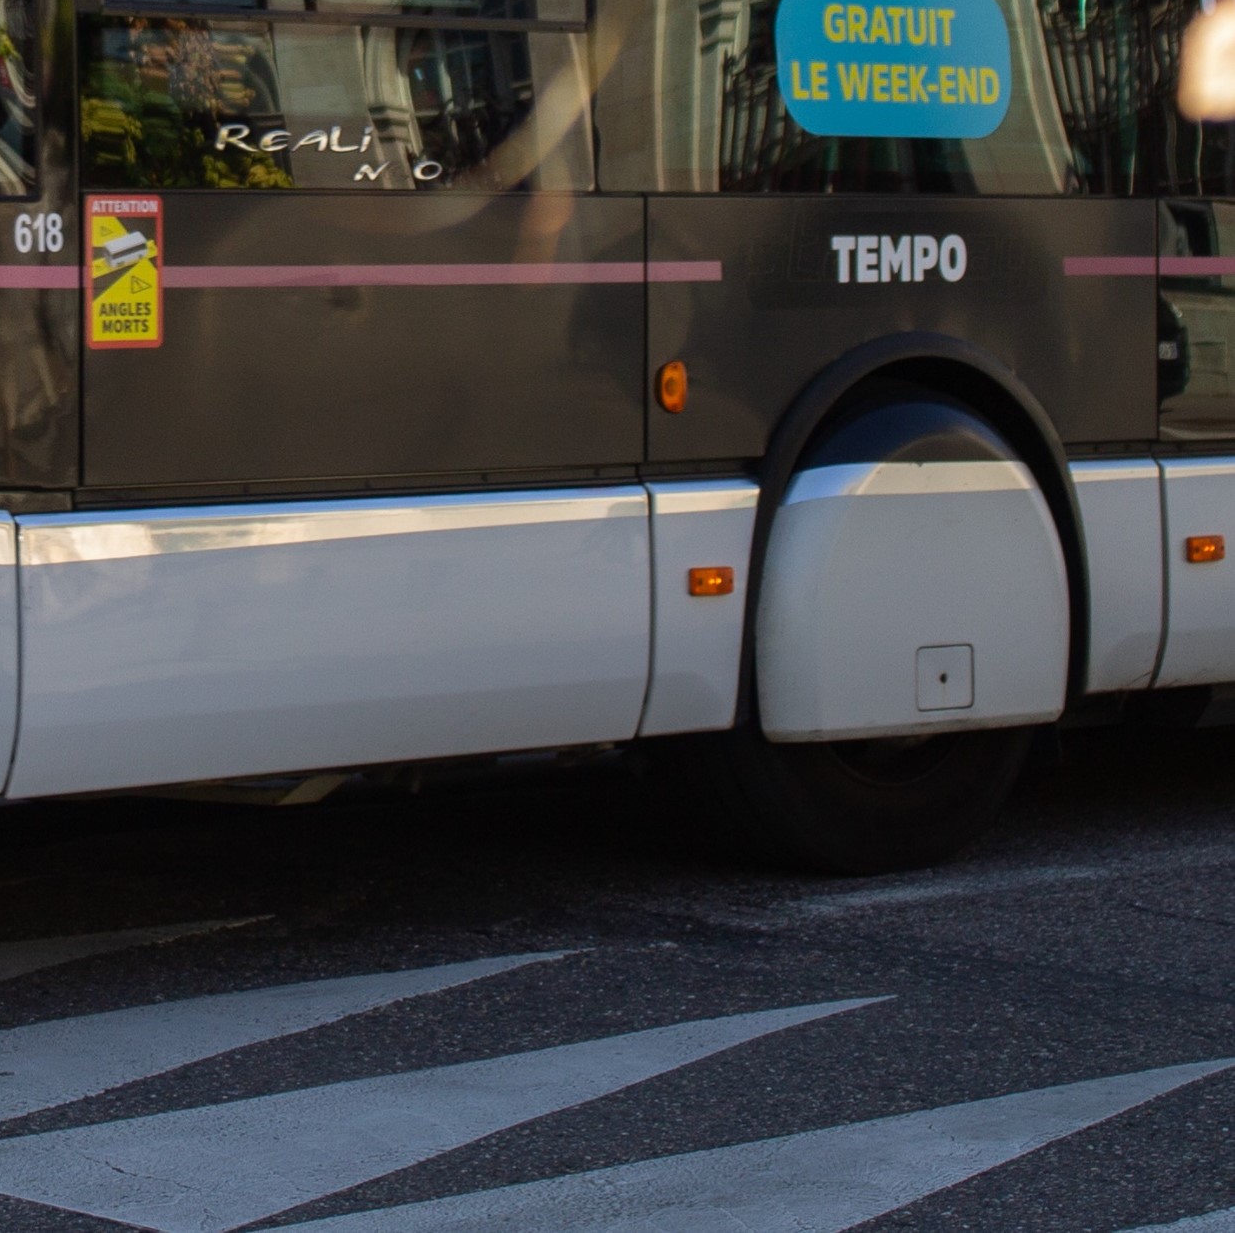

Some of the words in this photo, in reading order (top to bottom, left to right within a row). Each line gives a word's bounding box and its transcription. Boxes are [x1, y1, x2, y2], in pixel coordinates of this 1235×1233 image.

[823, 3, 956, 46] GRATUIT
[791, 61, 830, 101] LE
[837, 62, 1000, 106] WEEK-END
[91, 200, 159, 213] ATTENTION
[14, 212, 64, 254] 618
[831, 232, 968, 284] TEMPO
[99, 302, 152, 317] ANGLES
[102, 319, 150, 334] MORTS
